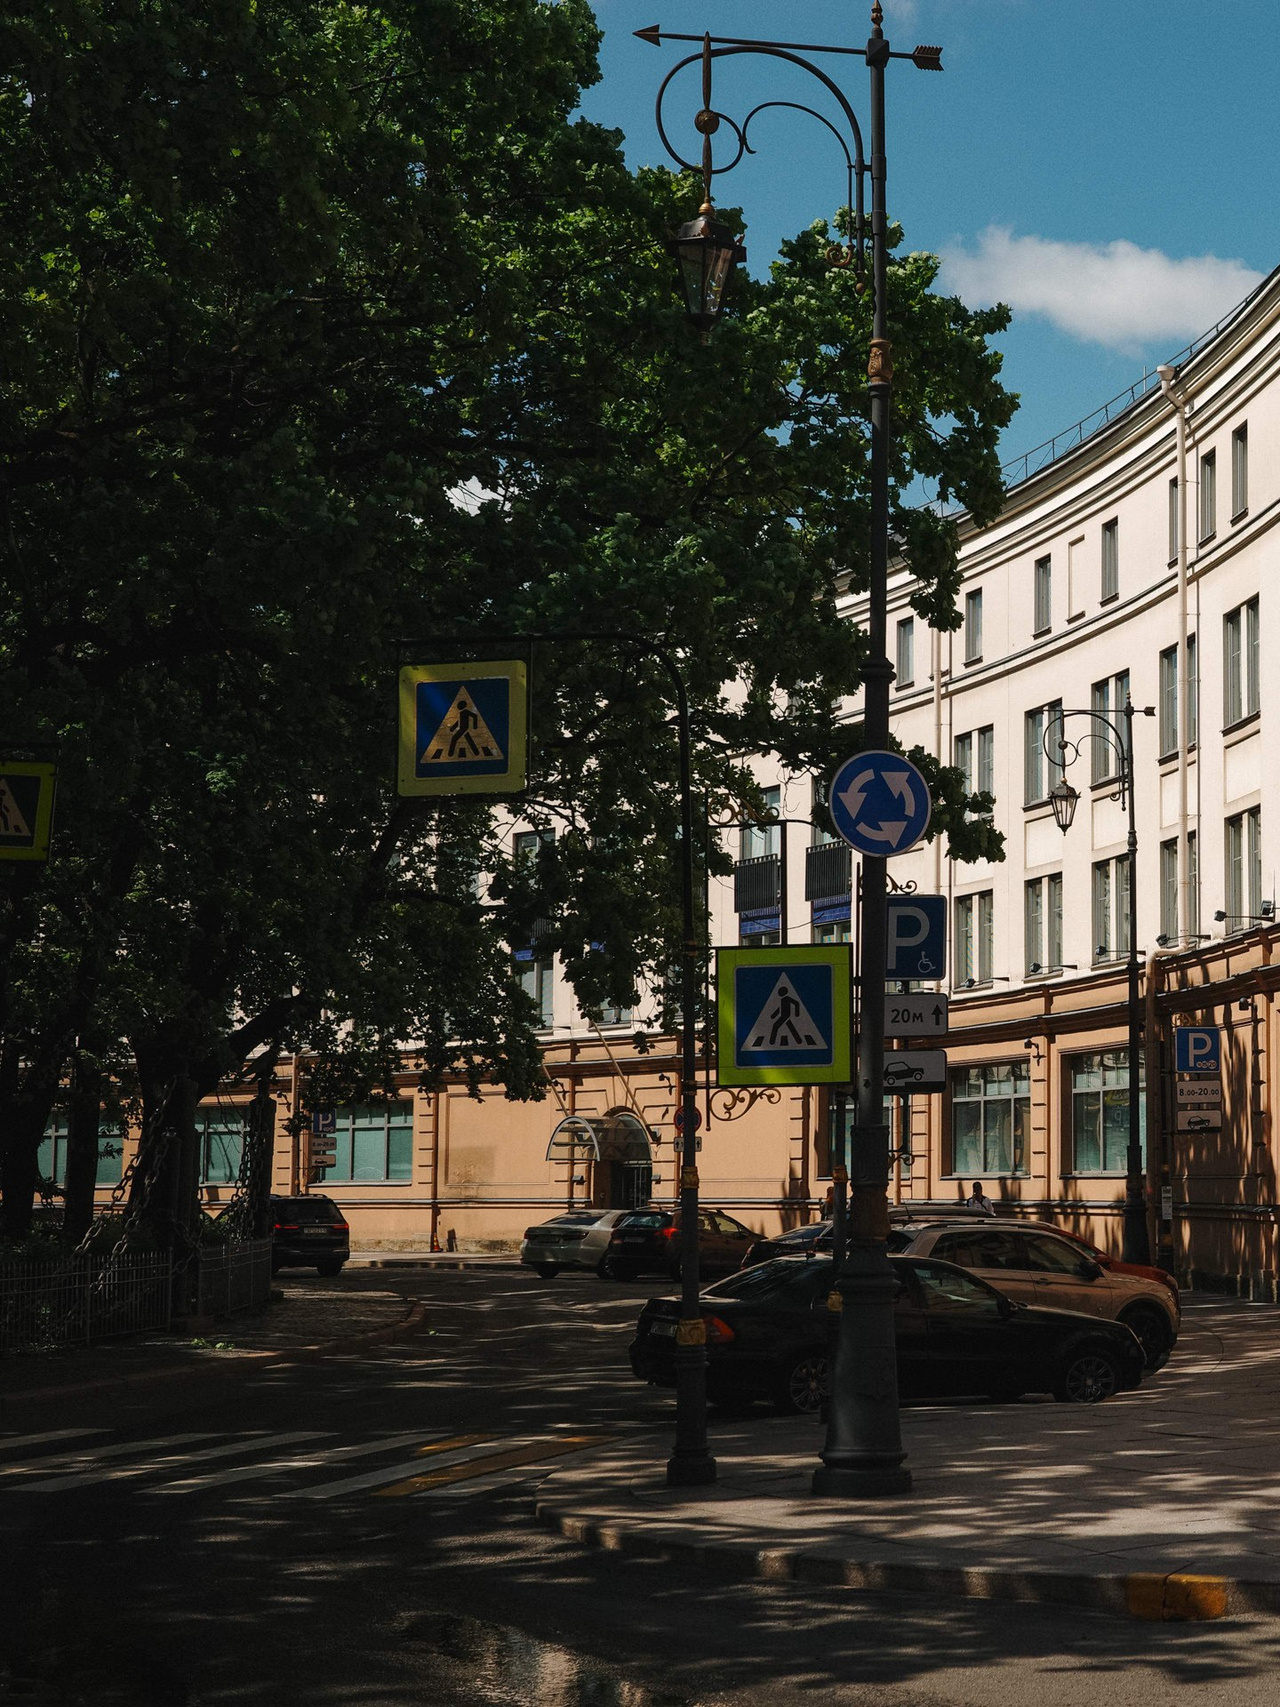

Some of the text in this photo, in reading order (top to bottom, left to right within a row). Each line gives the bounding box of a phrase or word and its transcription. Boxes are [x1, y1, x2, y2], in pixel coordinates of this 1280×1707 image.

[887, 906, 930, 970] P
[1188, 1032, 1212, 1068] P
[1179, 1087, 1220, 1097] 8.00-20.00
